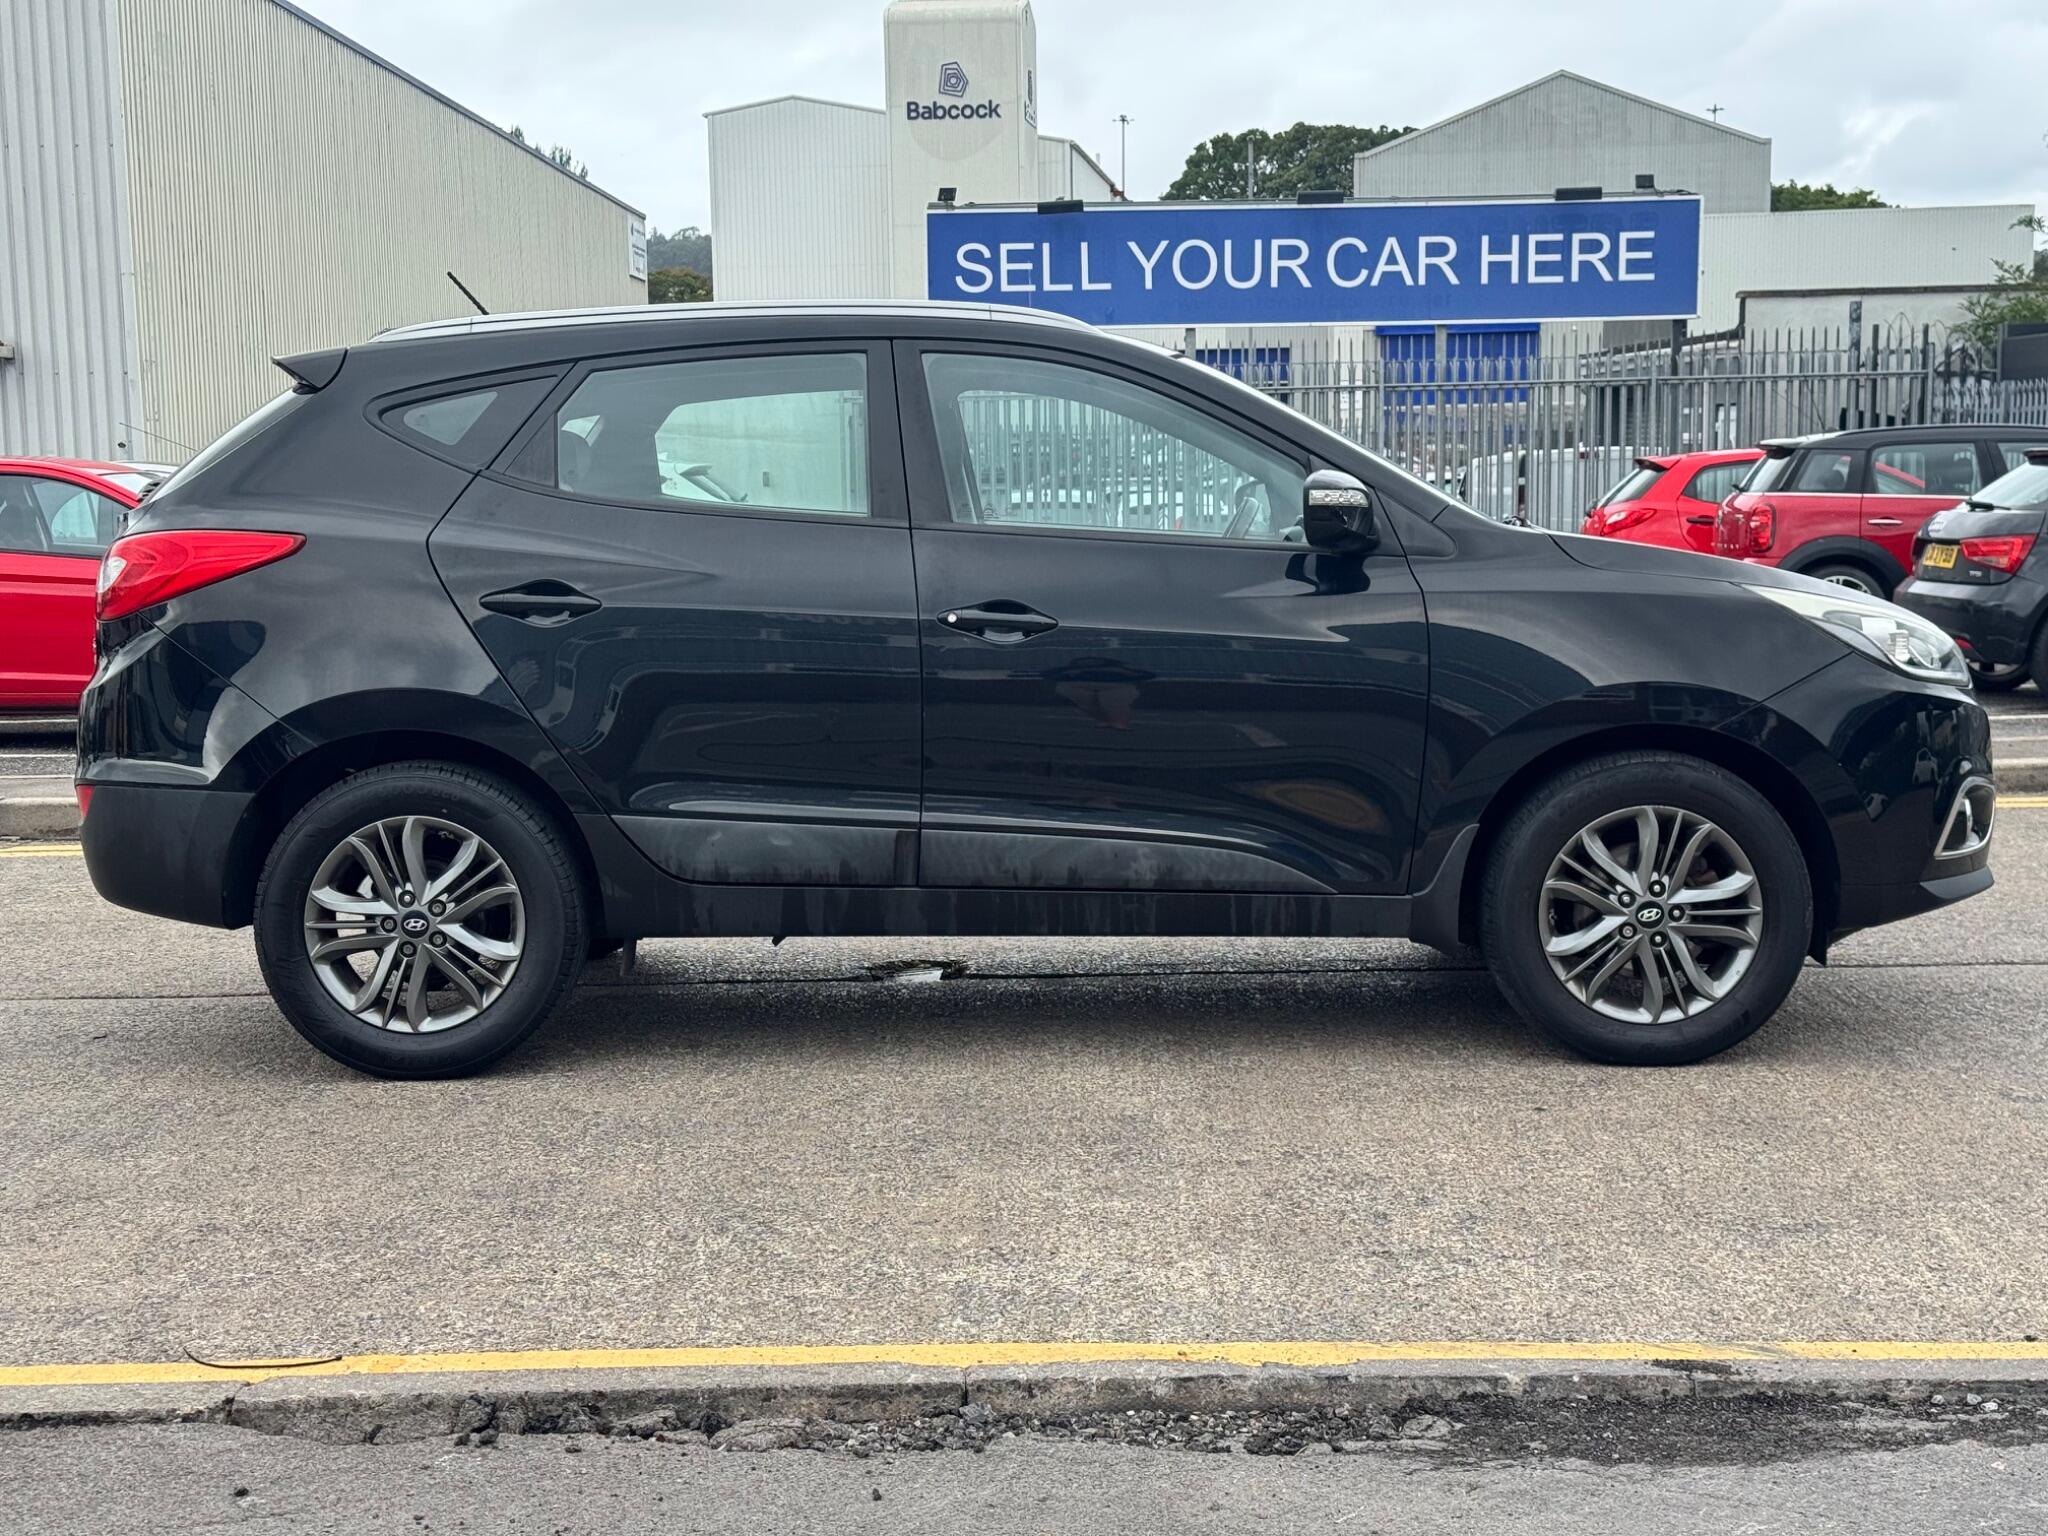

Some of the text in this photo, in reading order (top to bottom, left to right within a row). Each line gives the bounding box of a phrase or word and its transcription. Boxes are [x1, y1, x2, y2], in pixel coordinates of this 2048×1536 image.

[906, 99, 1002, 121] Babcock
[955, 230, 1656, 293] SELL YOUR CAR HERE
